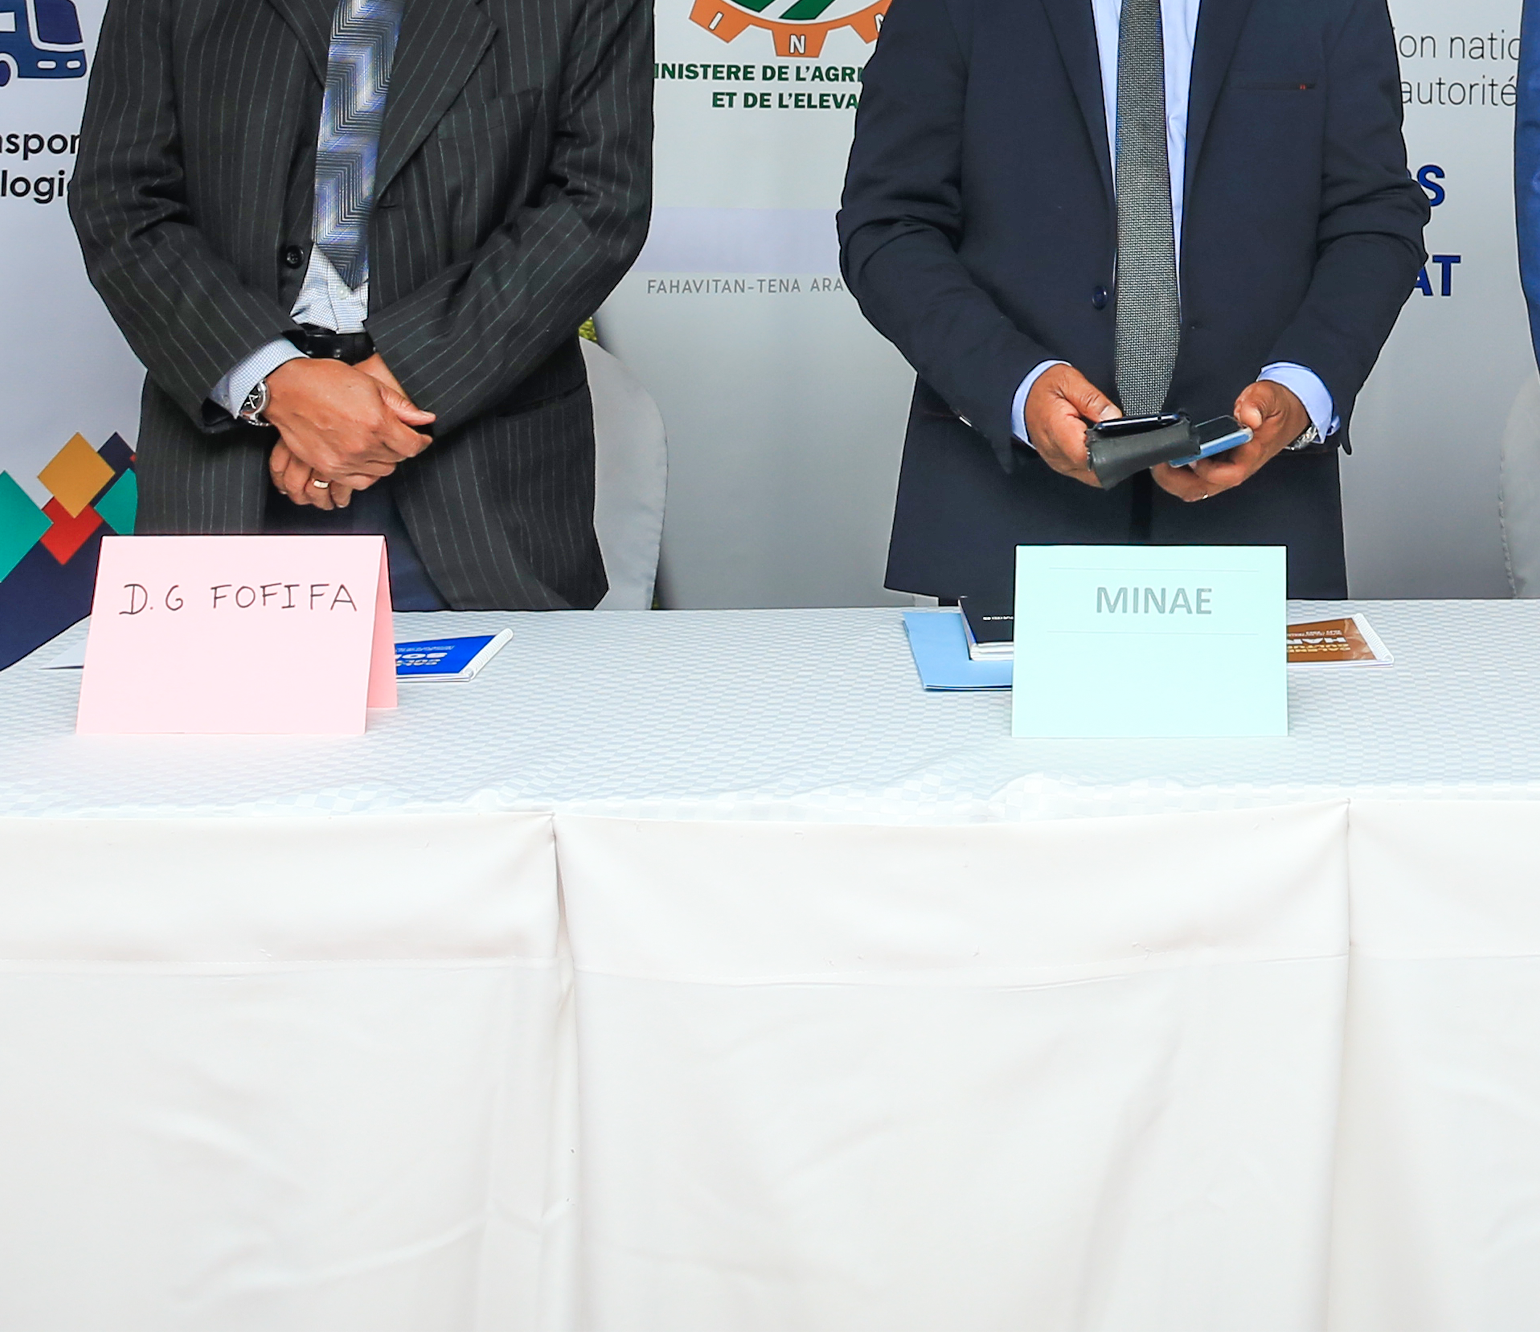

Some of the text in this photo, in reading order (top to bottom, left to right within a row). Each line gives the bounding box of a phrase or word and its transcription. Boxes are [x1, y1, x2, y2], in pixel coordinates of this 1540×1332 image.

[762, 65, 789, 81] DE
[713, 92, 737, 108] ET
[743, 93, 771, 108] DE
[647, 278, 801, 294] FAHAVITAN-TENA
[211, 582, 358, 612] FOFIFA
[1096, 586, 1213, 616] MINAE
